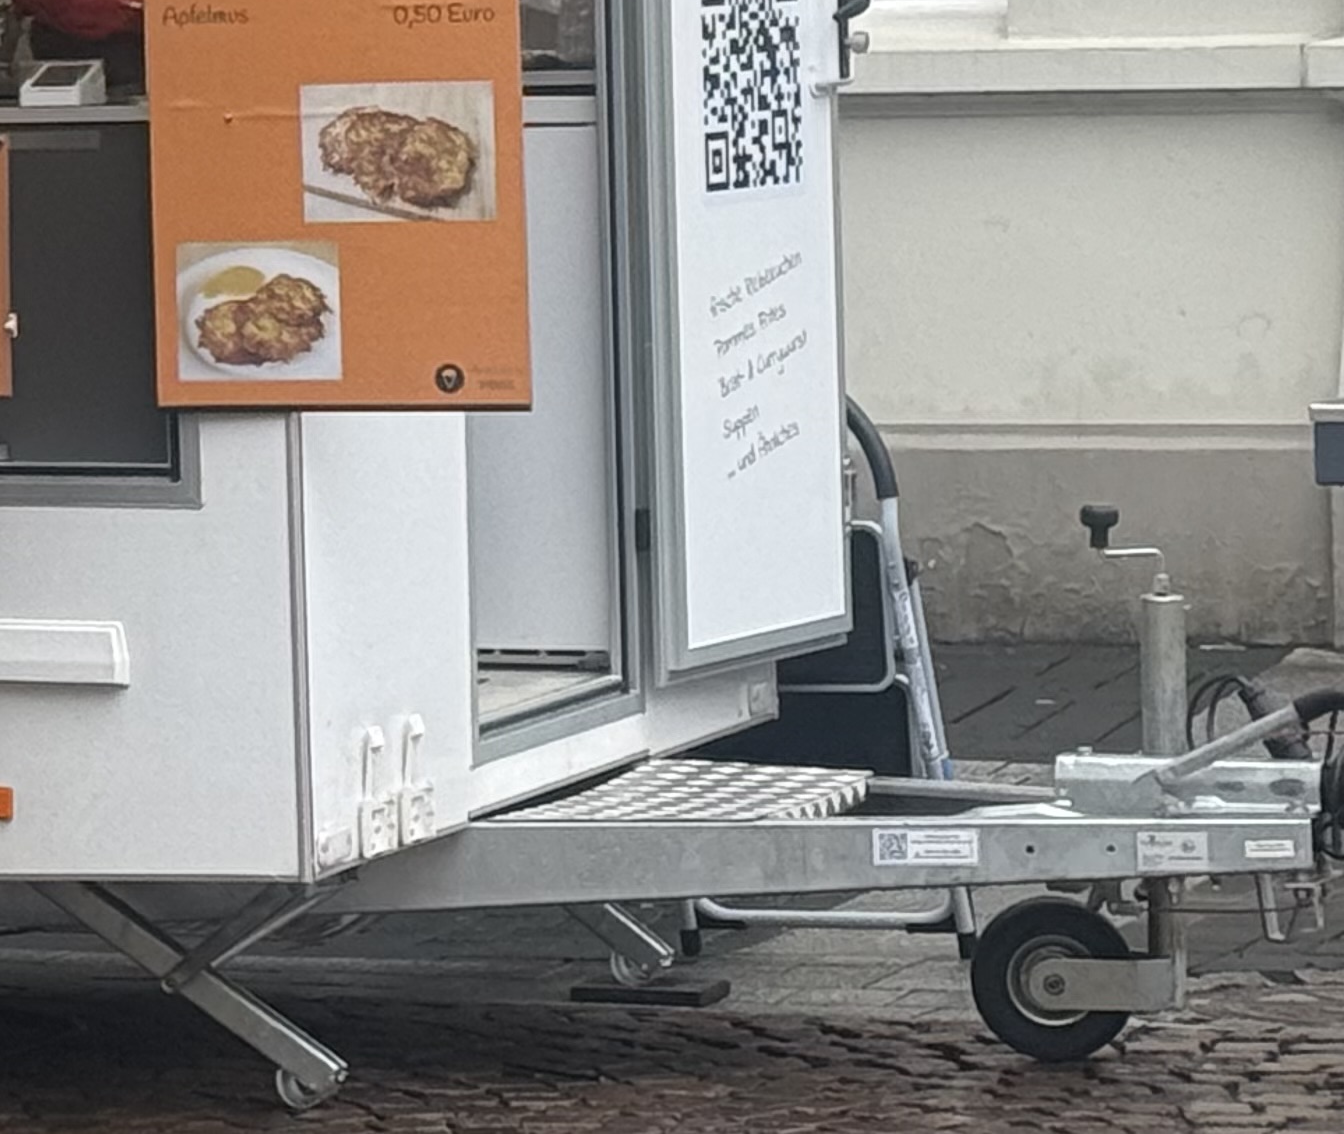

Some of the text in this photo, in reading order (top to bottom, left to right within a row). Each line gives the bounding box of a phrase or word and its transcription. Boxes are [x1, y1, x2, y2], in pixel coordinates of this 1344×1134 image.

[162, 2, 496, 29] Apfelmus 0,50 Euro
